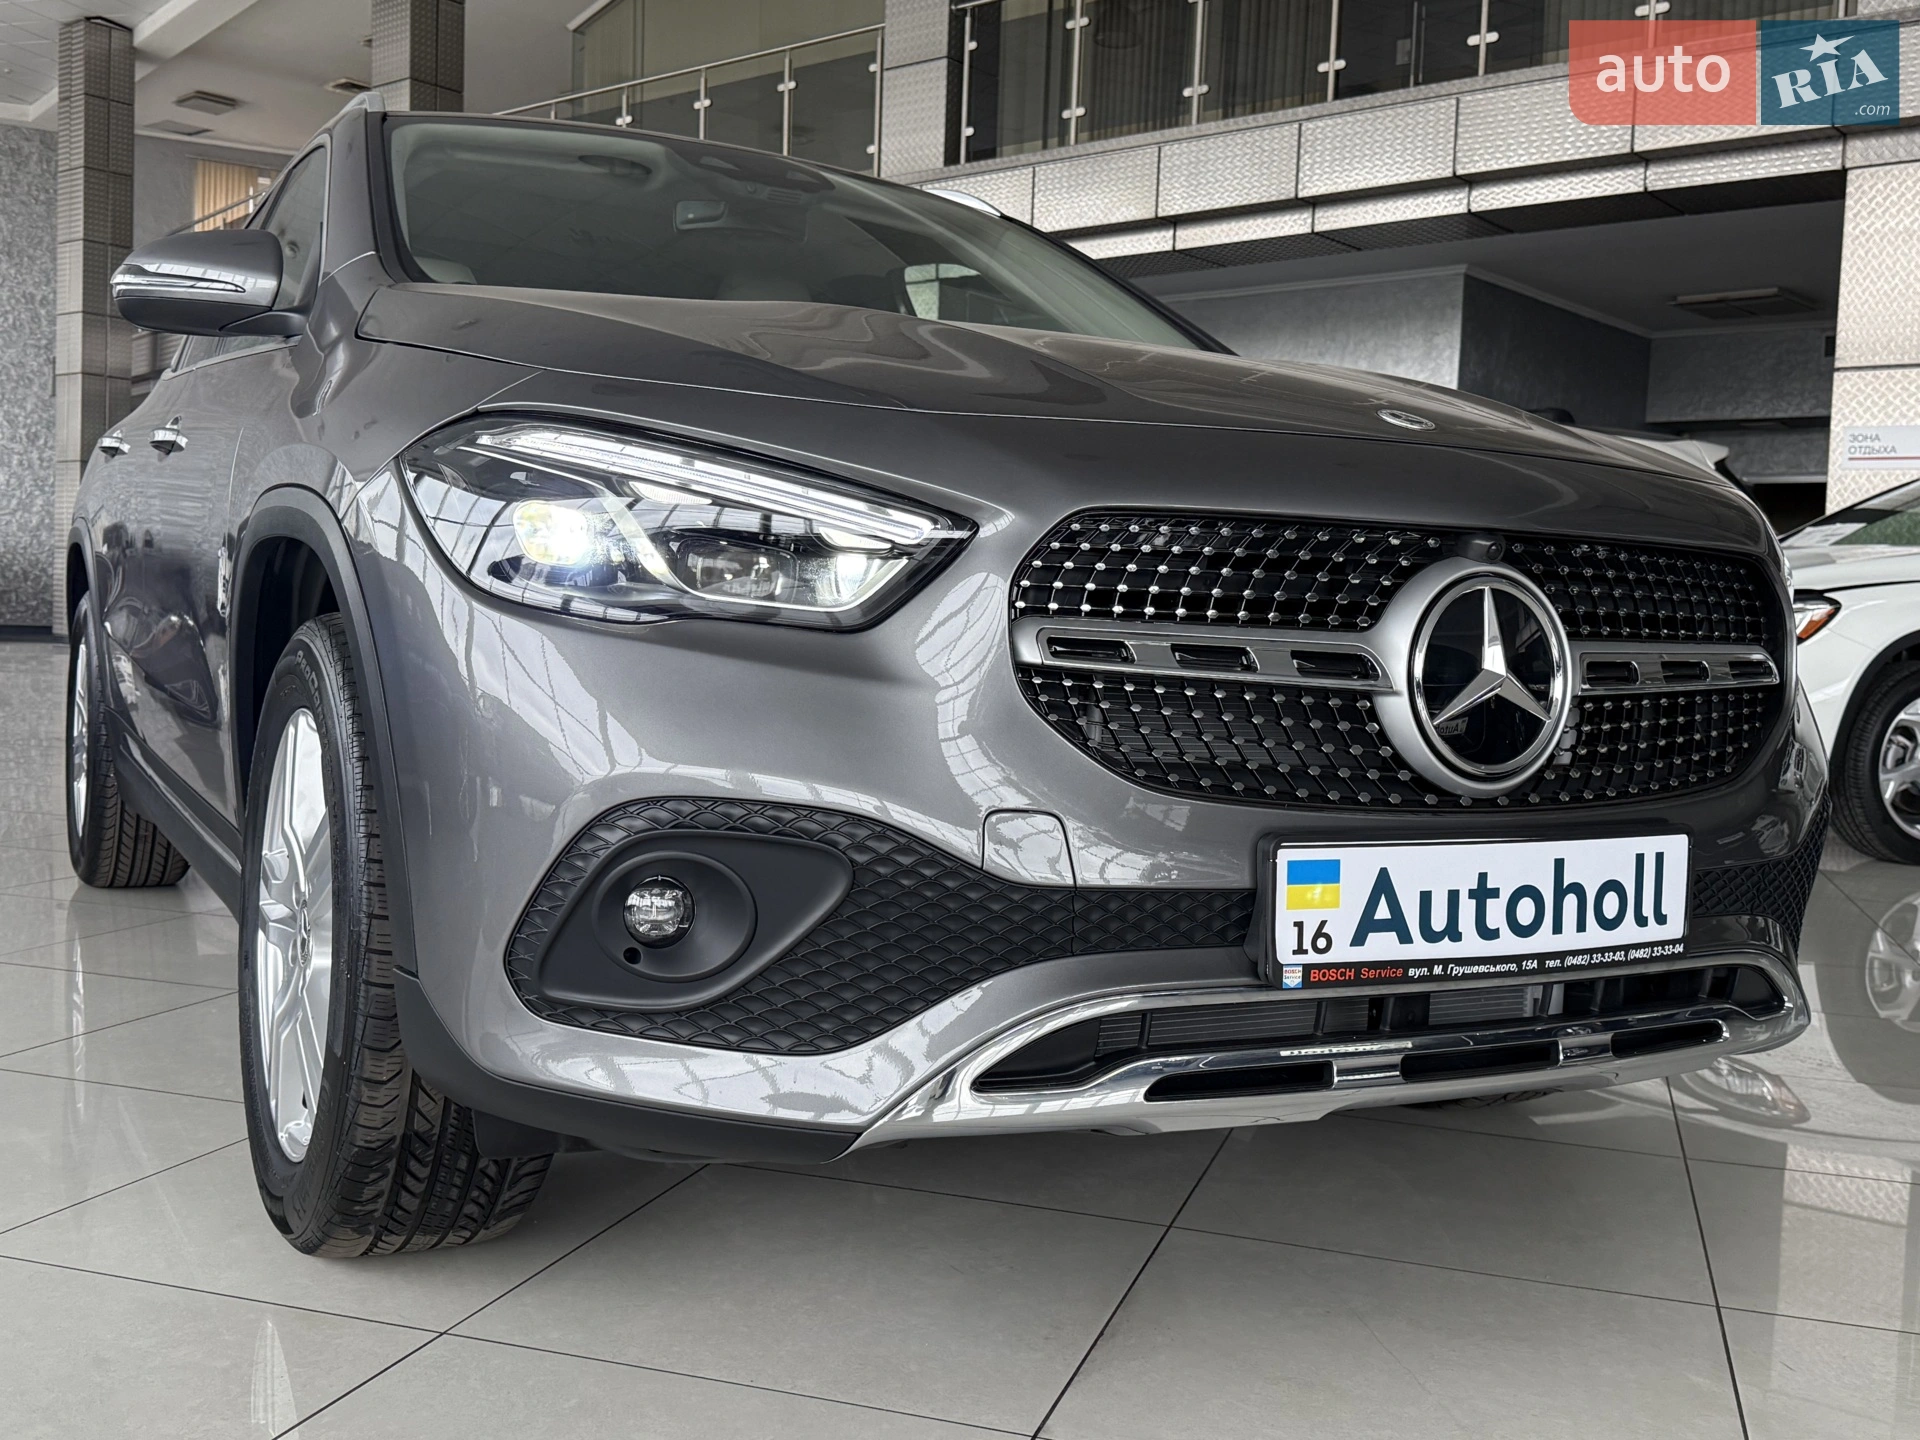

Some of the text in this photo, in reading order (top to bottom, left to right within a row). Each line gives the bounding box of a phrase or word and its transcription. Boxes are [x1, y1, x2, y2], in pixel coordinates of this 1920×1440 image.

[1848, 433, 1881, 443] ЗОНА
[1848, 445, 1897, 455] ОТДЫХА
[1349, 851, 1668, 947] Autoholl
[1292, 919, 1333, 956] 16
[1408, 967, 1430, 978] вул.
[1447, 961, 1519, 977] Грушевського,
[1545, 959, 1562, 968] тел.
[1564, 953, 1590, 968] (0482)
[1590, 950, 1626, 964] 33-33-03,
[1627, 946, 1652, 961] (0482)
[1652, 942, 1684, 957] 33-33-04
[1310, 966, 1404, 982] BOSCH Service
